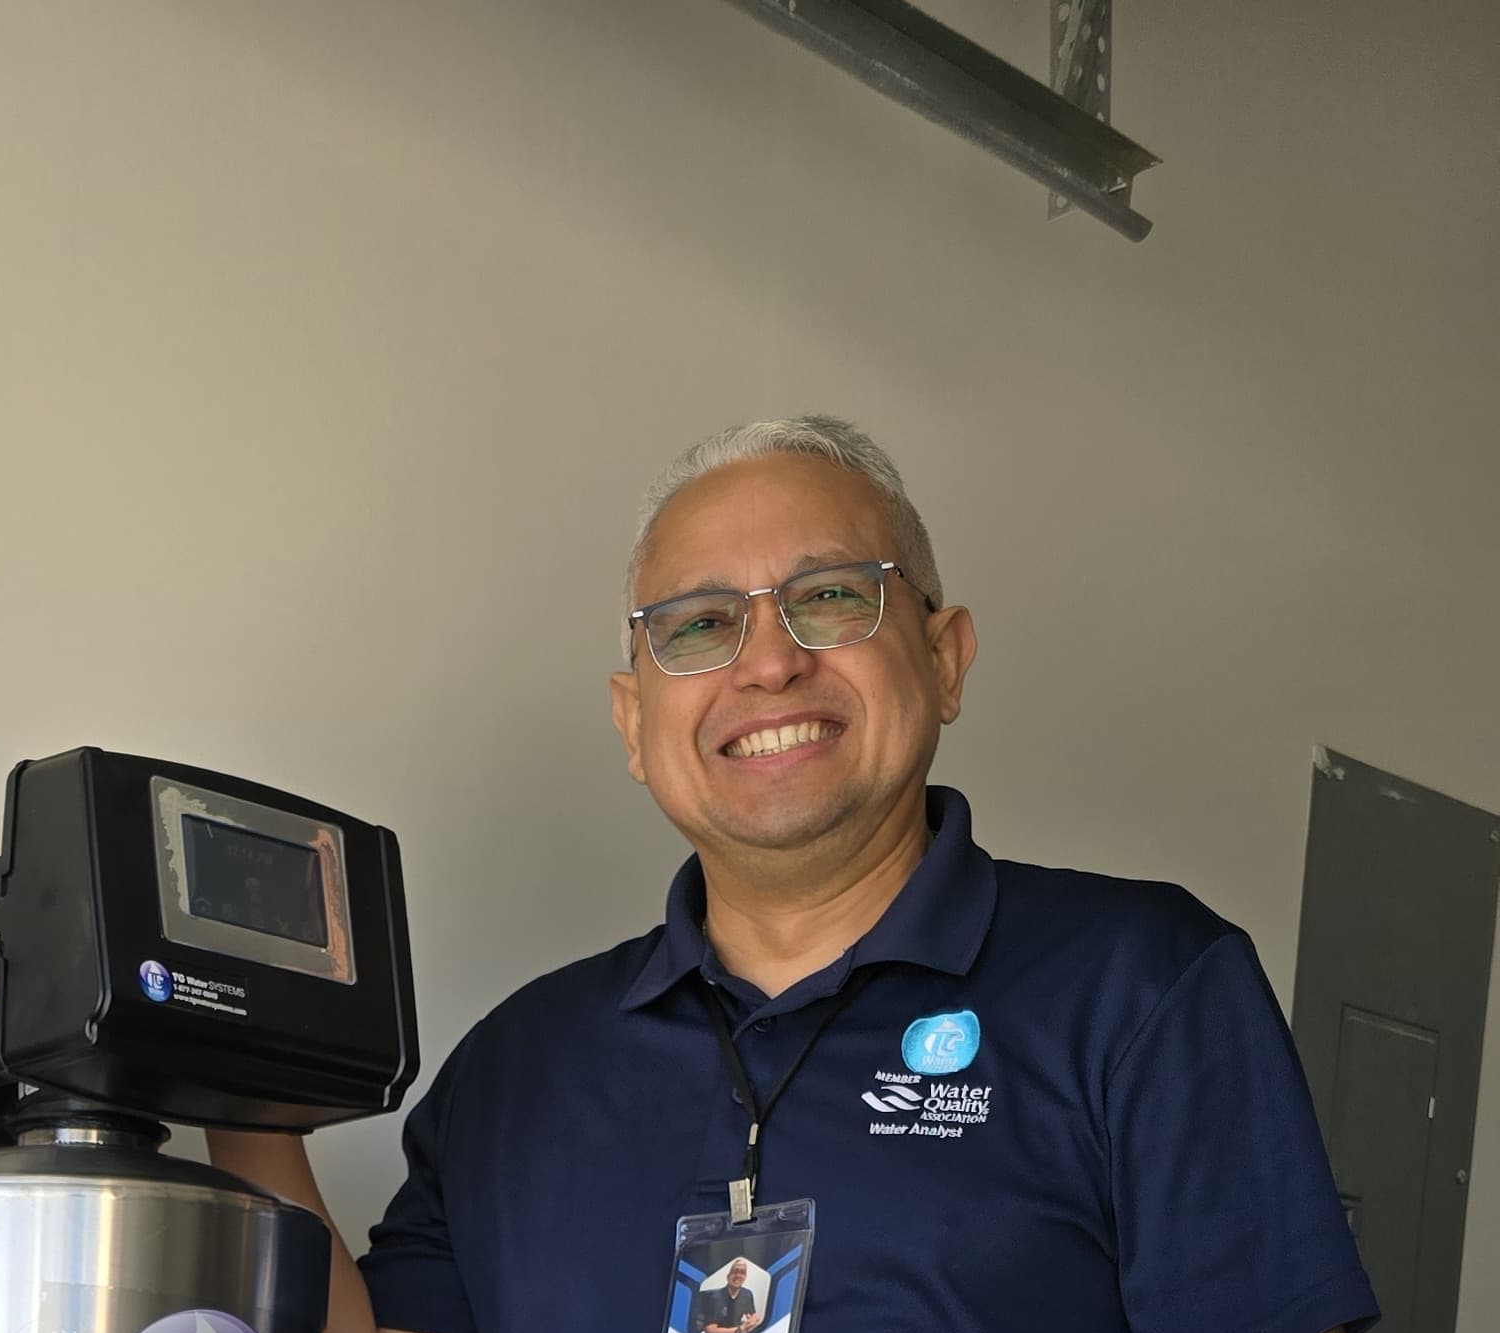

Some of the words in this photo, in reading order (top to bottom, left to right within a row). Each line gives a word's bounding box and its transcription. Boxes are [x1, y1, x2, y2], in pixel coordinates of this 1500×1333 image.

[208, 981, 246, 998] SYSTEMS
[875, 1070, 922, 1084] MEMBER
[930, 1083, 992, 1100] Water
[920, 1111, 987, 1124] ASSOCIATION
[869, 1122, 908, 1135] Water
[908, 1122, 963, 1138] Analyst
